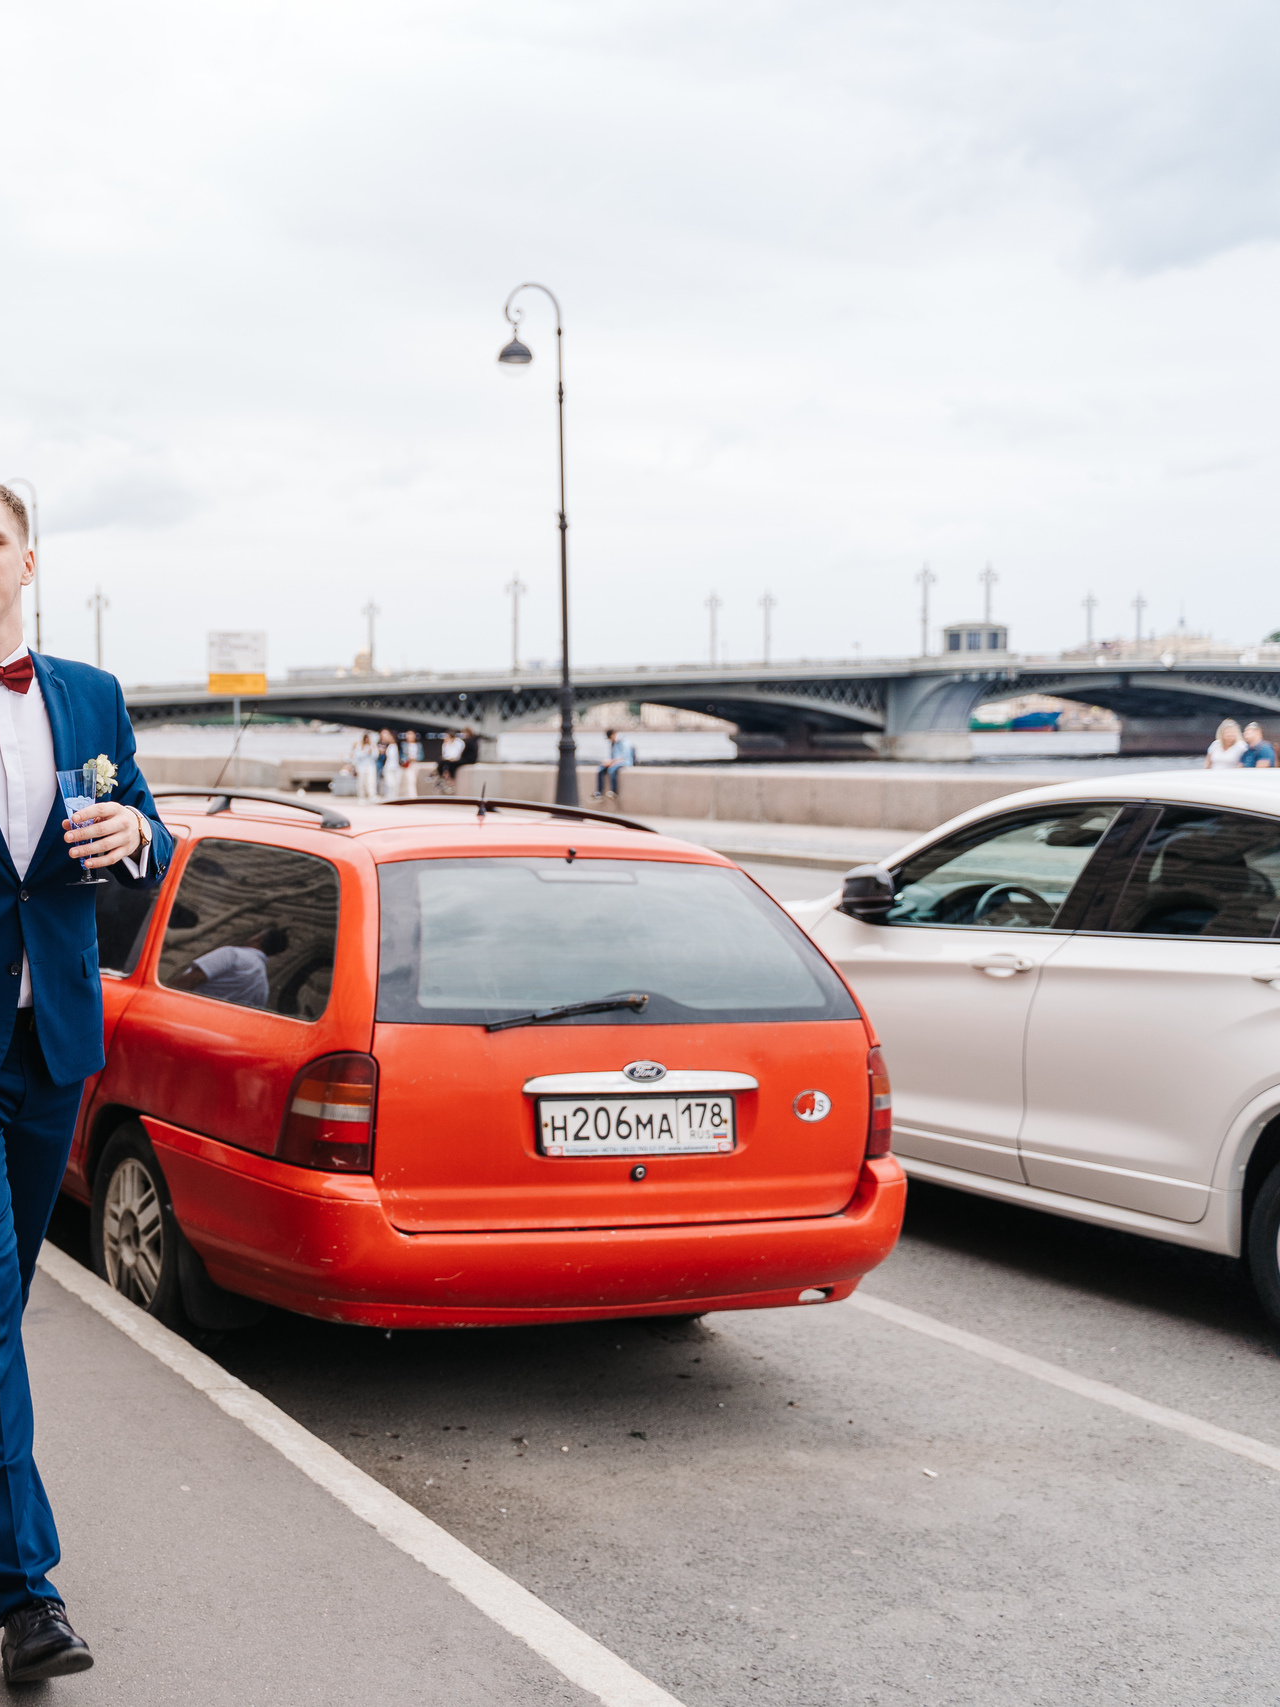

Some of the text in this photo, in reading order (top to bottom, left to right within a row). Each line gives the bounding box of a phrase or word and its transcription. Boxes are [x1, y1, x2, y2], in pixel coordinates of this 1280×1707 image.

[633, 1064, 658, 1077] Ford
[680, 1103, 723, 1129] 178
[689, 1129, 713, 1140] RUS
